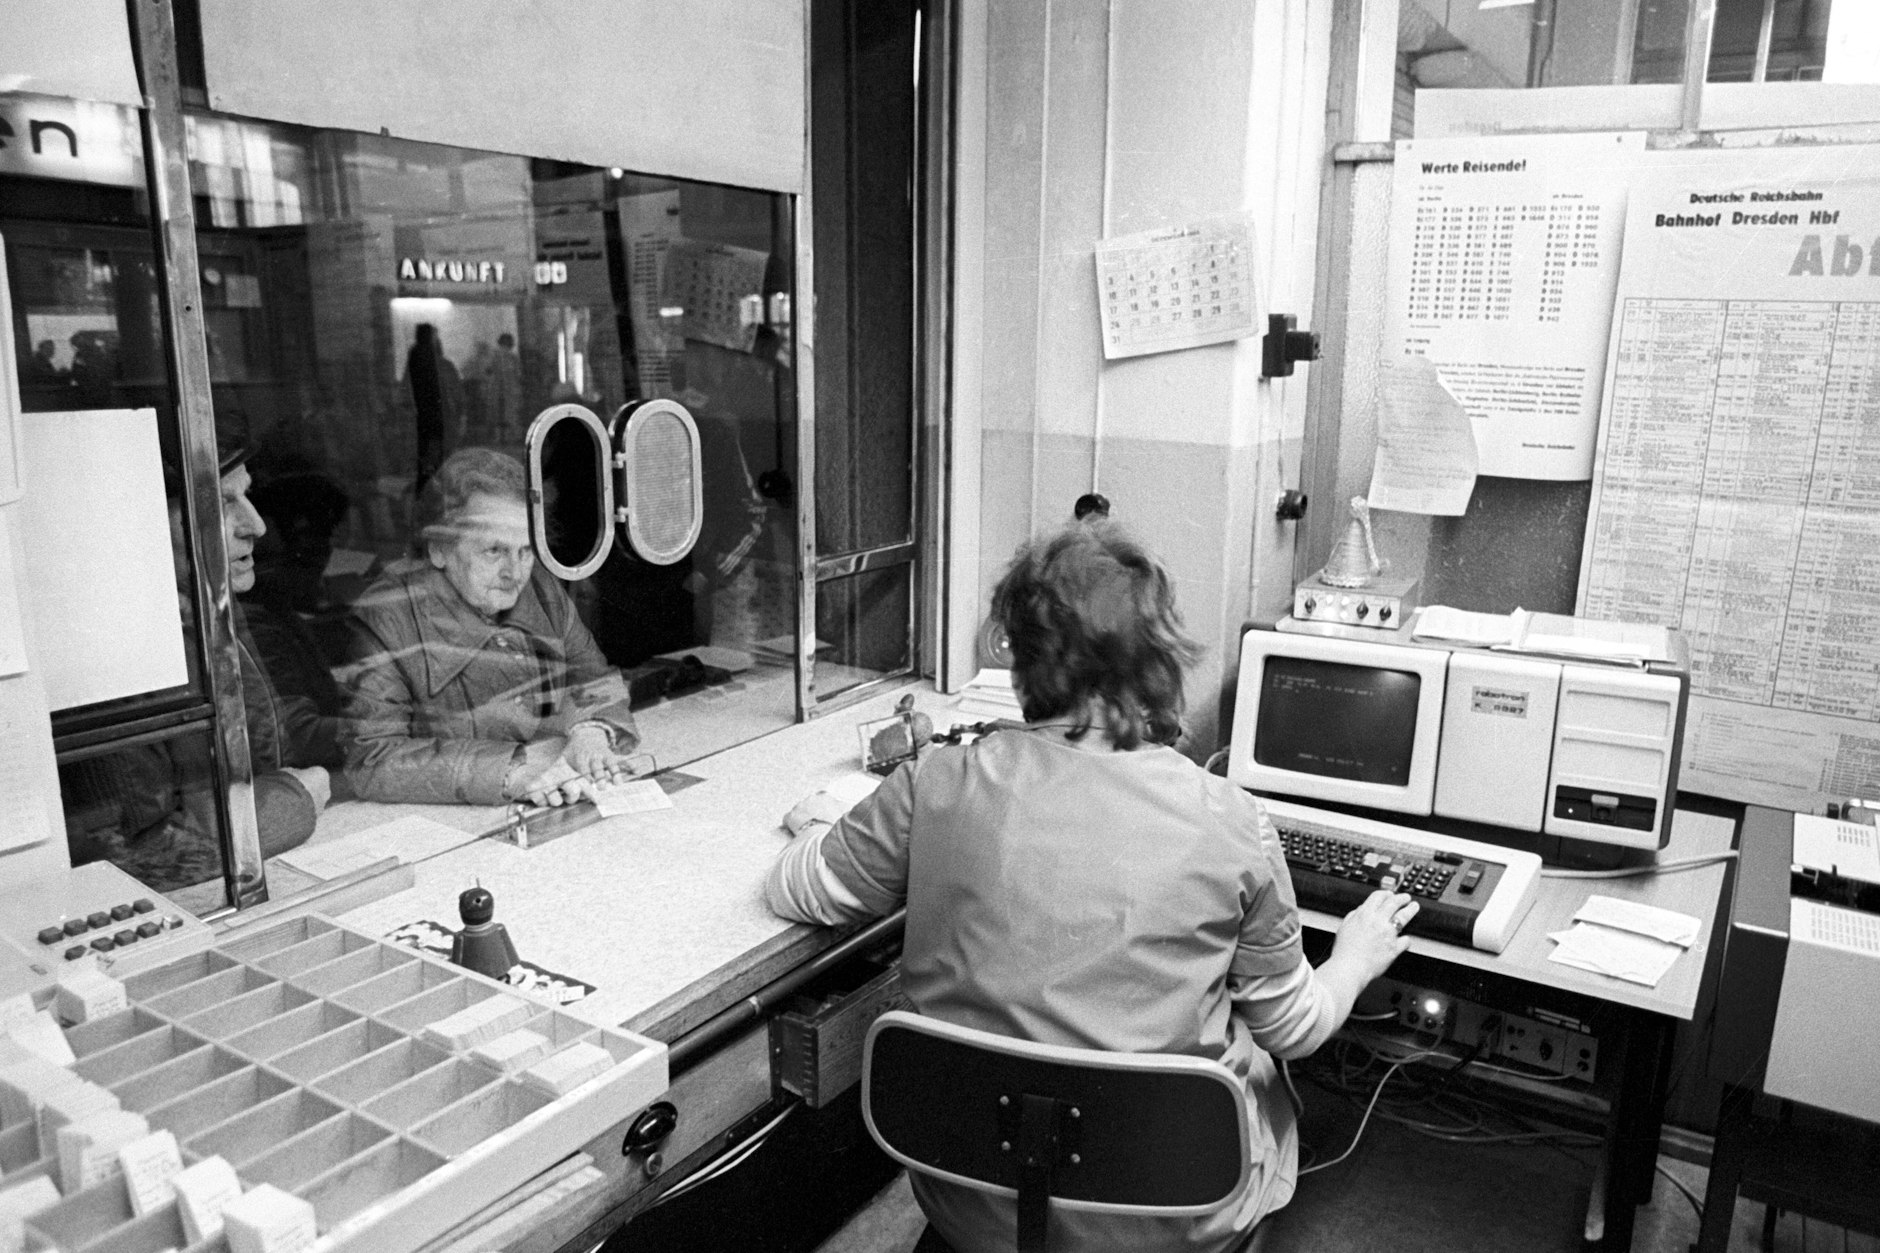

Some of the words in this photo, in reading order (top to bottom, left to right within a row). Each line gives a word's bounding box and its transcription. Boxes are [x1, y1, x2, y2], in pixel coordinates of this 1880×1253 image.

[1421, 161, 1459, 175] Werte
[1463, 159, 1527, 173] Reisende!
[1689, 192, 1745, 204] Deutsche
[1750, 190, 1823, 202] Reichsbahn
[1655, 212, 1721, 228] Bahnhof
[1731, 211, 1799, 226] Dresden
[1809, 210, 1840, 225] Hbf
[400, 257, 504, 283] ANKUNFT
[1109, 291, 1116, 300] 10
[1130, 288, 1137, 296] 11
[1150, 285, 1157, 294] 12
[1110, 306, 1117, 314] 17
[1131, 303, 1138, 311] 18
[1170, 297, 1181, 306] 20
[1211, 291, 1220, 299] 22
[1172, 312, 1182, 321] 27
[1193, 309, 1201, 318] 28
[1212, 305, 1221, 314] 29
[1475, 690, 1525, 702] robotron
